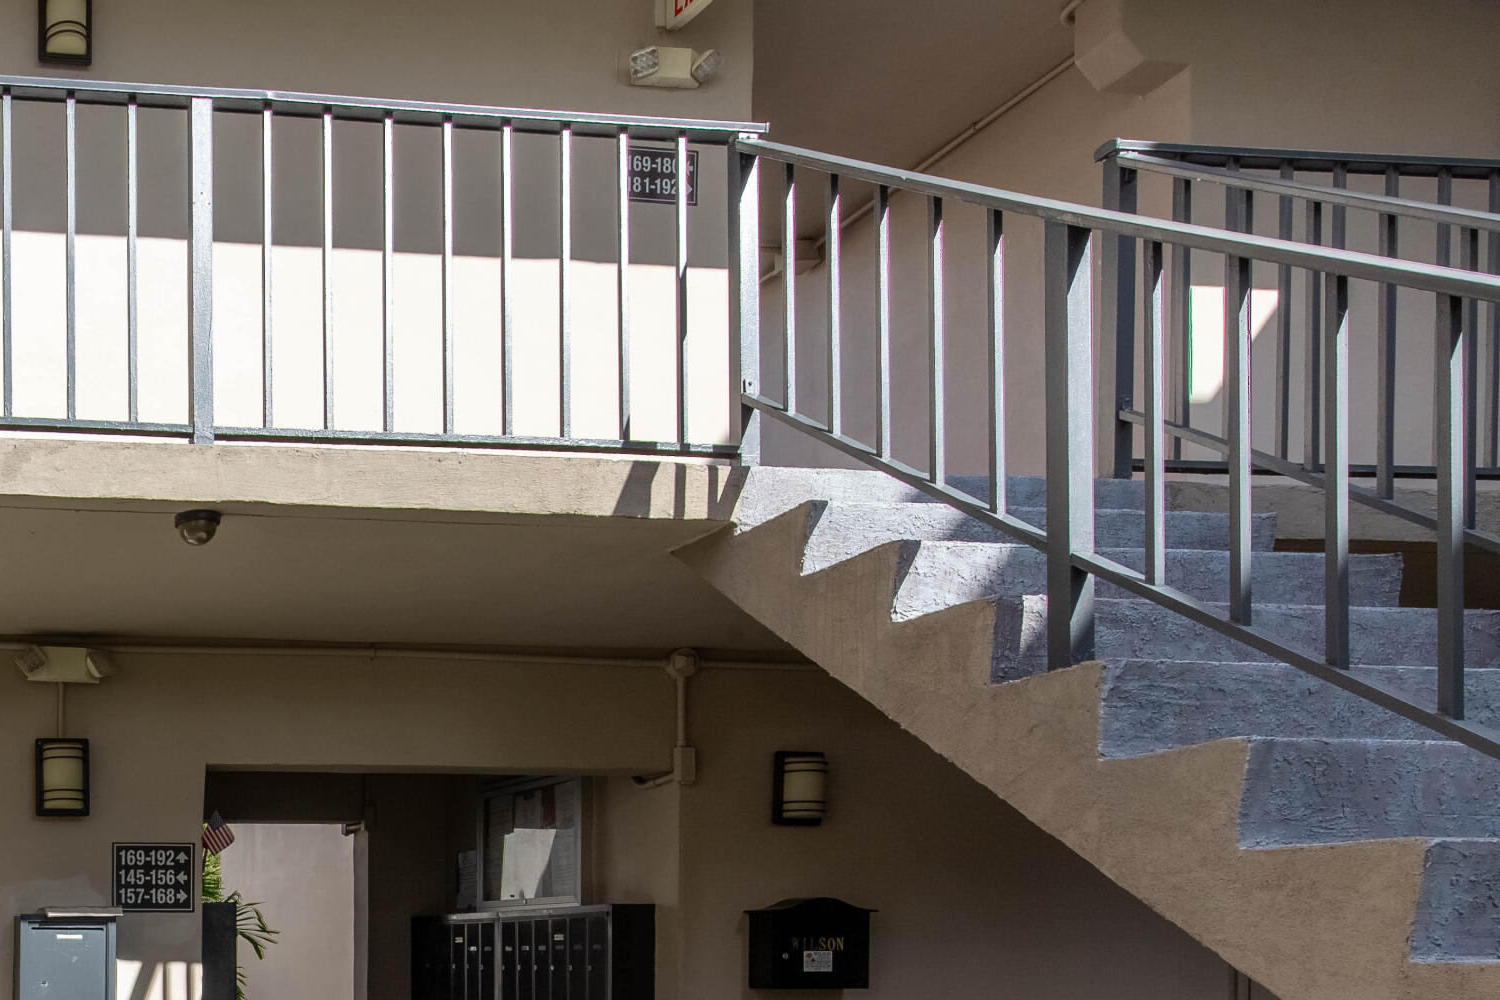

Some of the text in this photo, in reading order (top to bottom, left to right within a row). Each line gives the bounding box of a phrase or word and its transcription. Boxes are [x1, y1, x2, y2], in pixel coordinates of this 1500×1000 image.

[628, 155, 676, 174] 169-18
[119, 849, 175, 866] 169-192
[119, 869, 175, 885] 145-156
[119, 888, 175, 904] 157-168
[790, 936, 845, 952] WILSON
